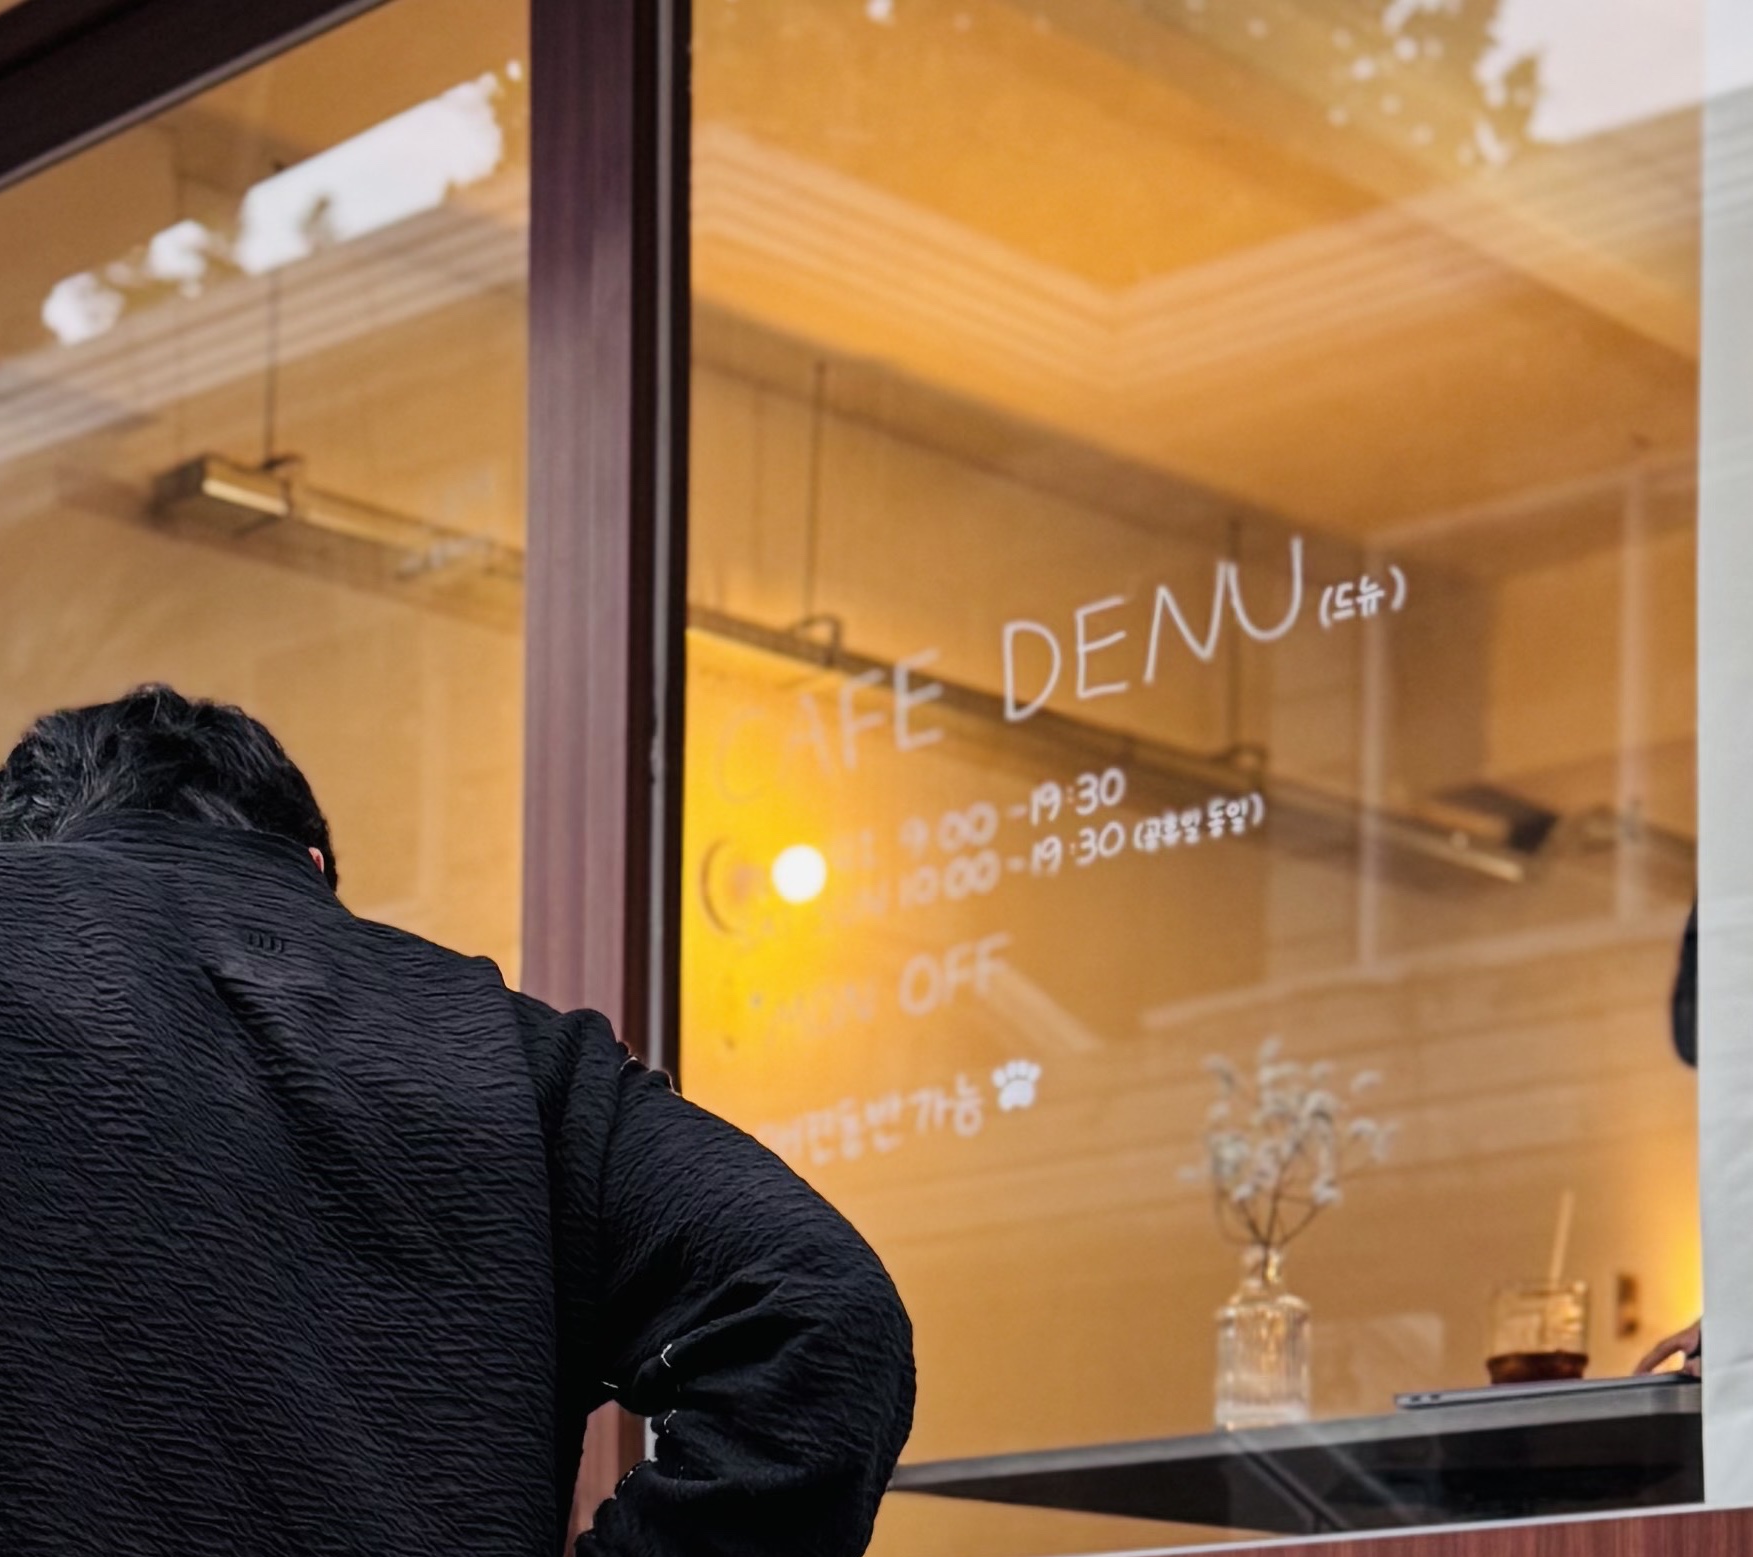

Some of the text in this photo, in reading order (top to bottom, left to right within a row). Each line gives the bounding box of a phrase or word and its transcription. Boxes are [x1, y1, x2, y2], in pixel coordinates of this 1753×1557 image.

[712, 645, 946, 803] CAFE
[1003, 535, 1302, 721] DENU
[898, 931, 1013, 1017] OFF
